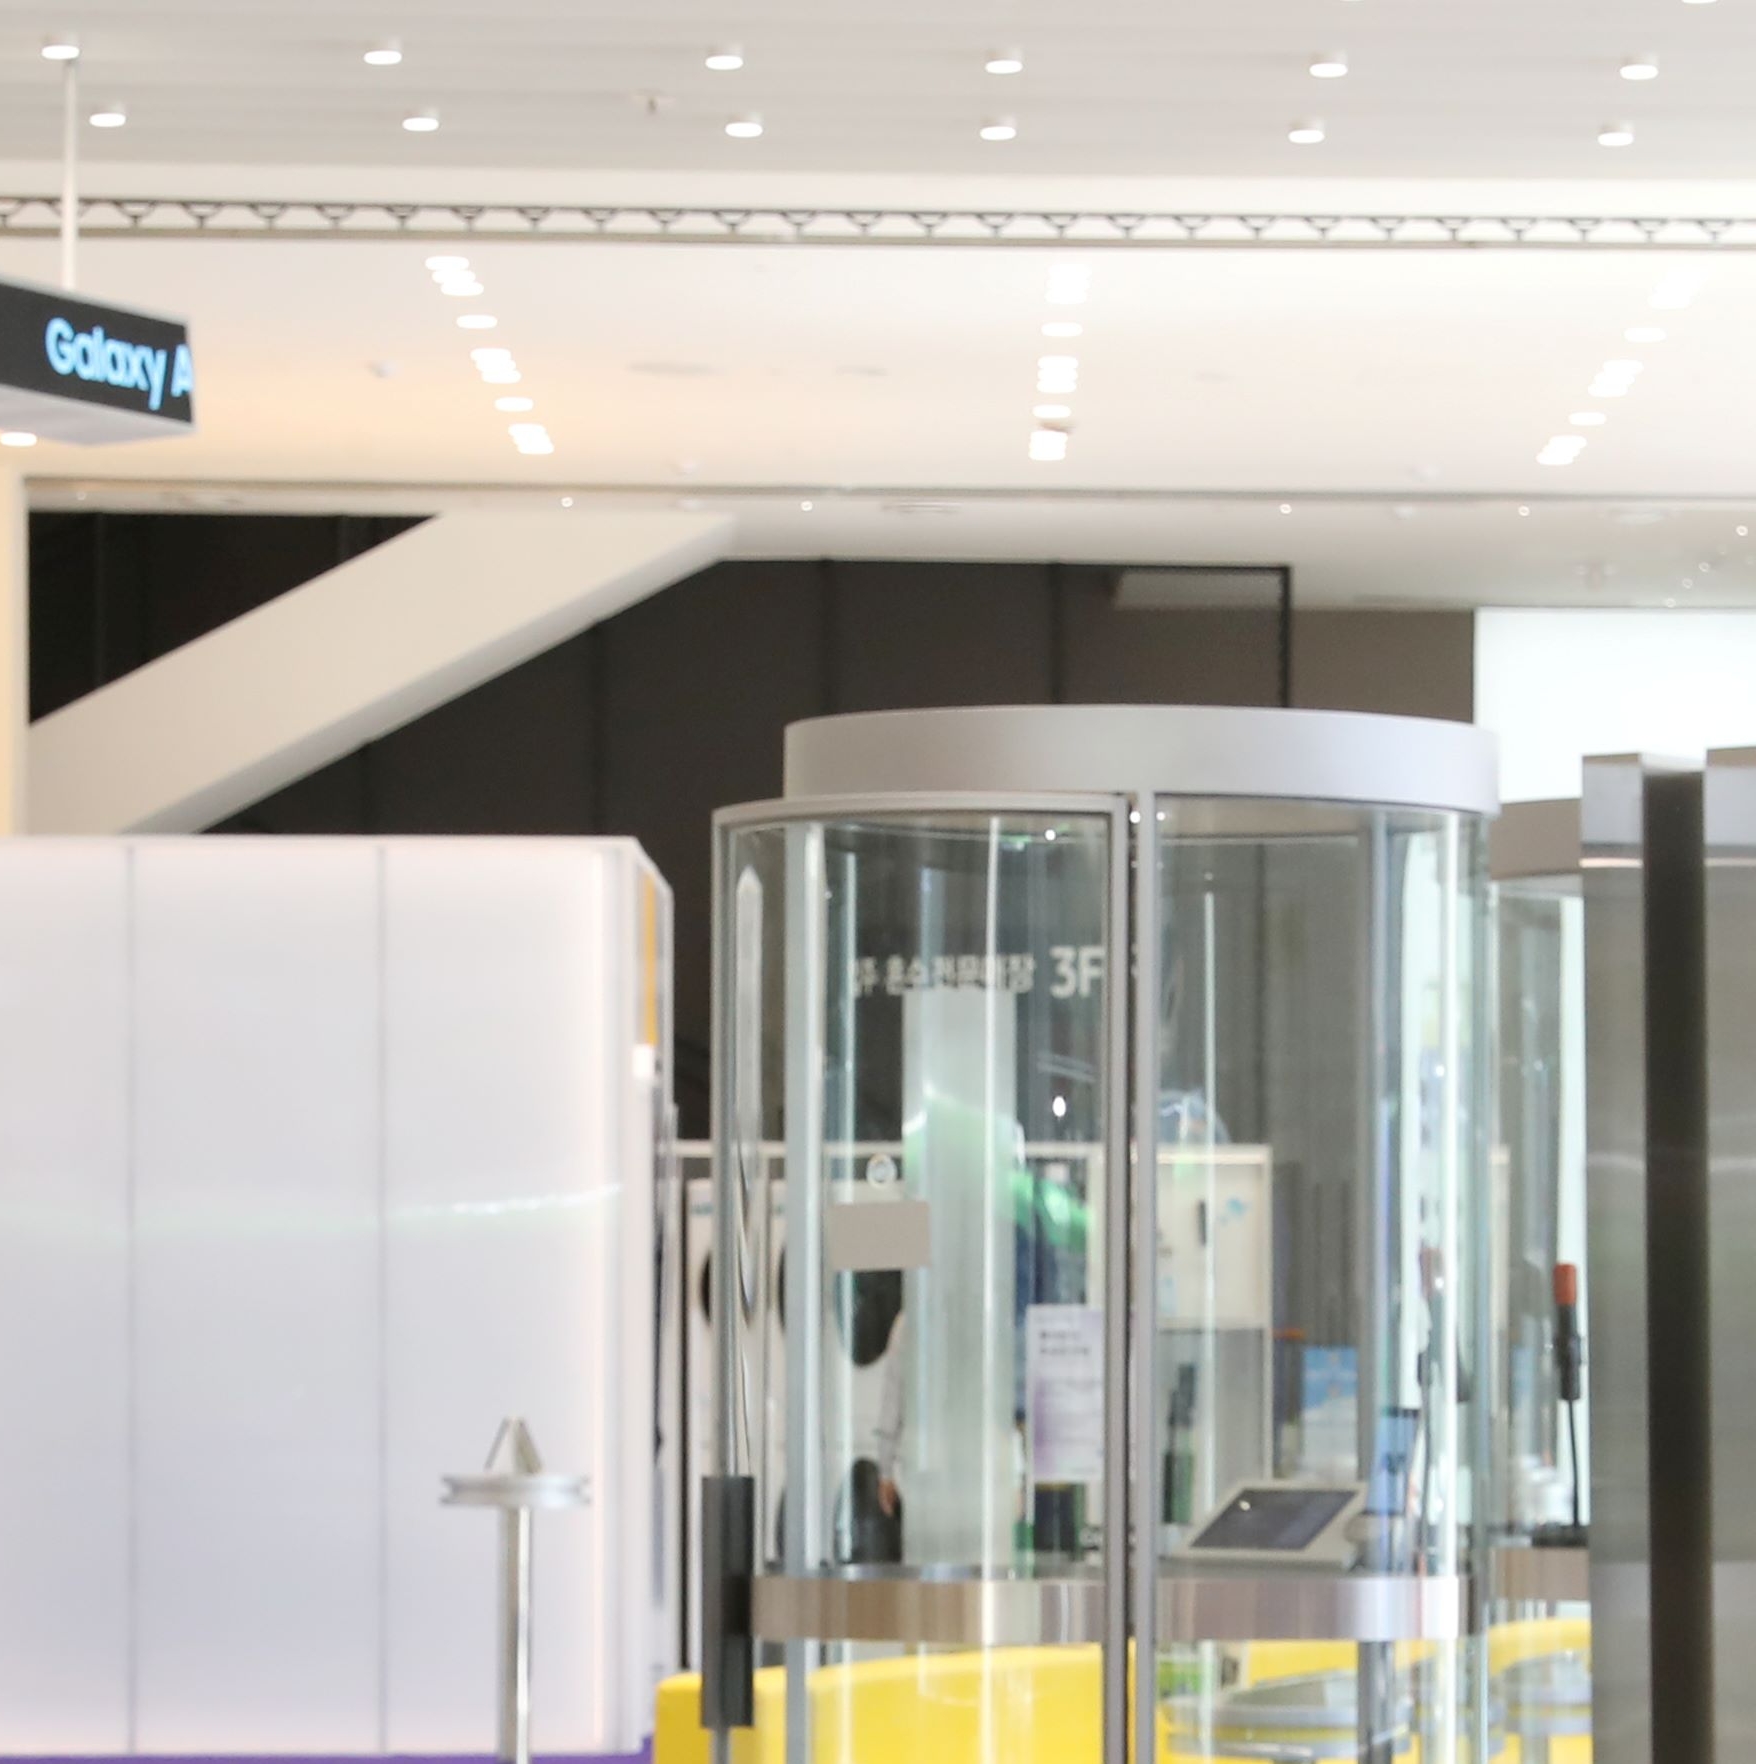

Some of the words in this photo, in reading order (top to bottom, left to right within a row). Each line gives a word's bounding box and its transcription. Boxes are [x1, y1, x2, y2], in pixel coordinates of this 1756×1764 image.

[45, 317, 167, 411] Galaxy
[171, 344, 194, 397] A
[1049, 944, 1106, 999] 3F
